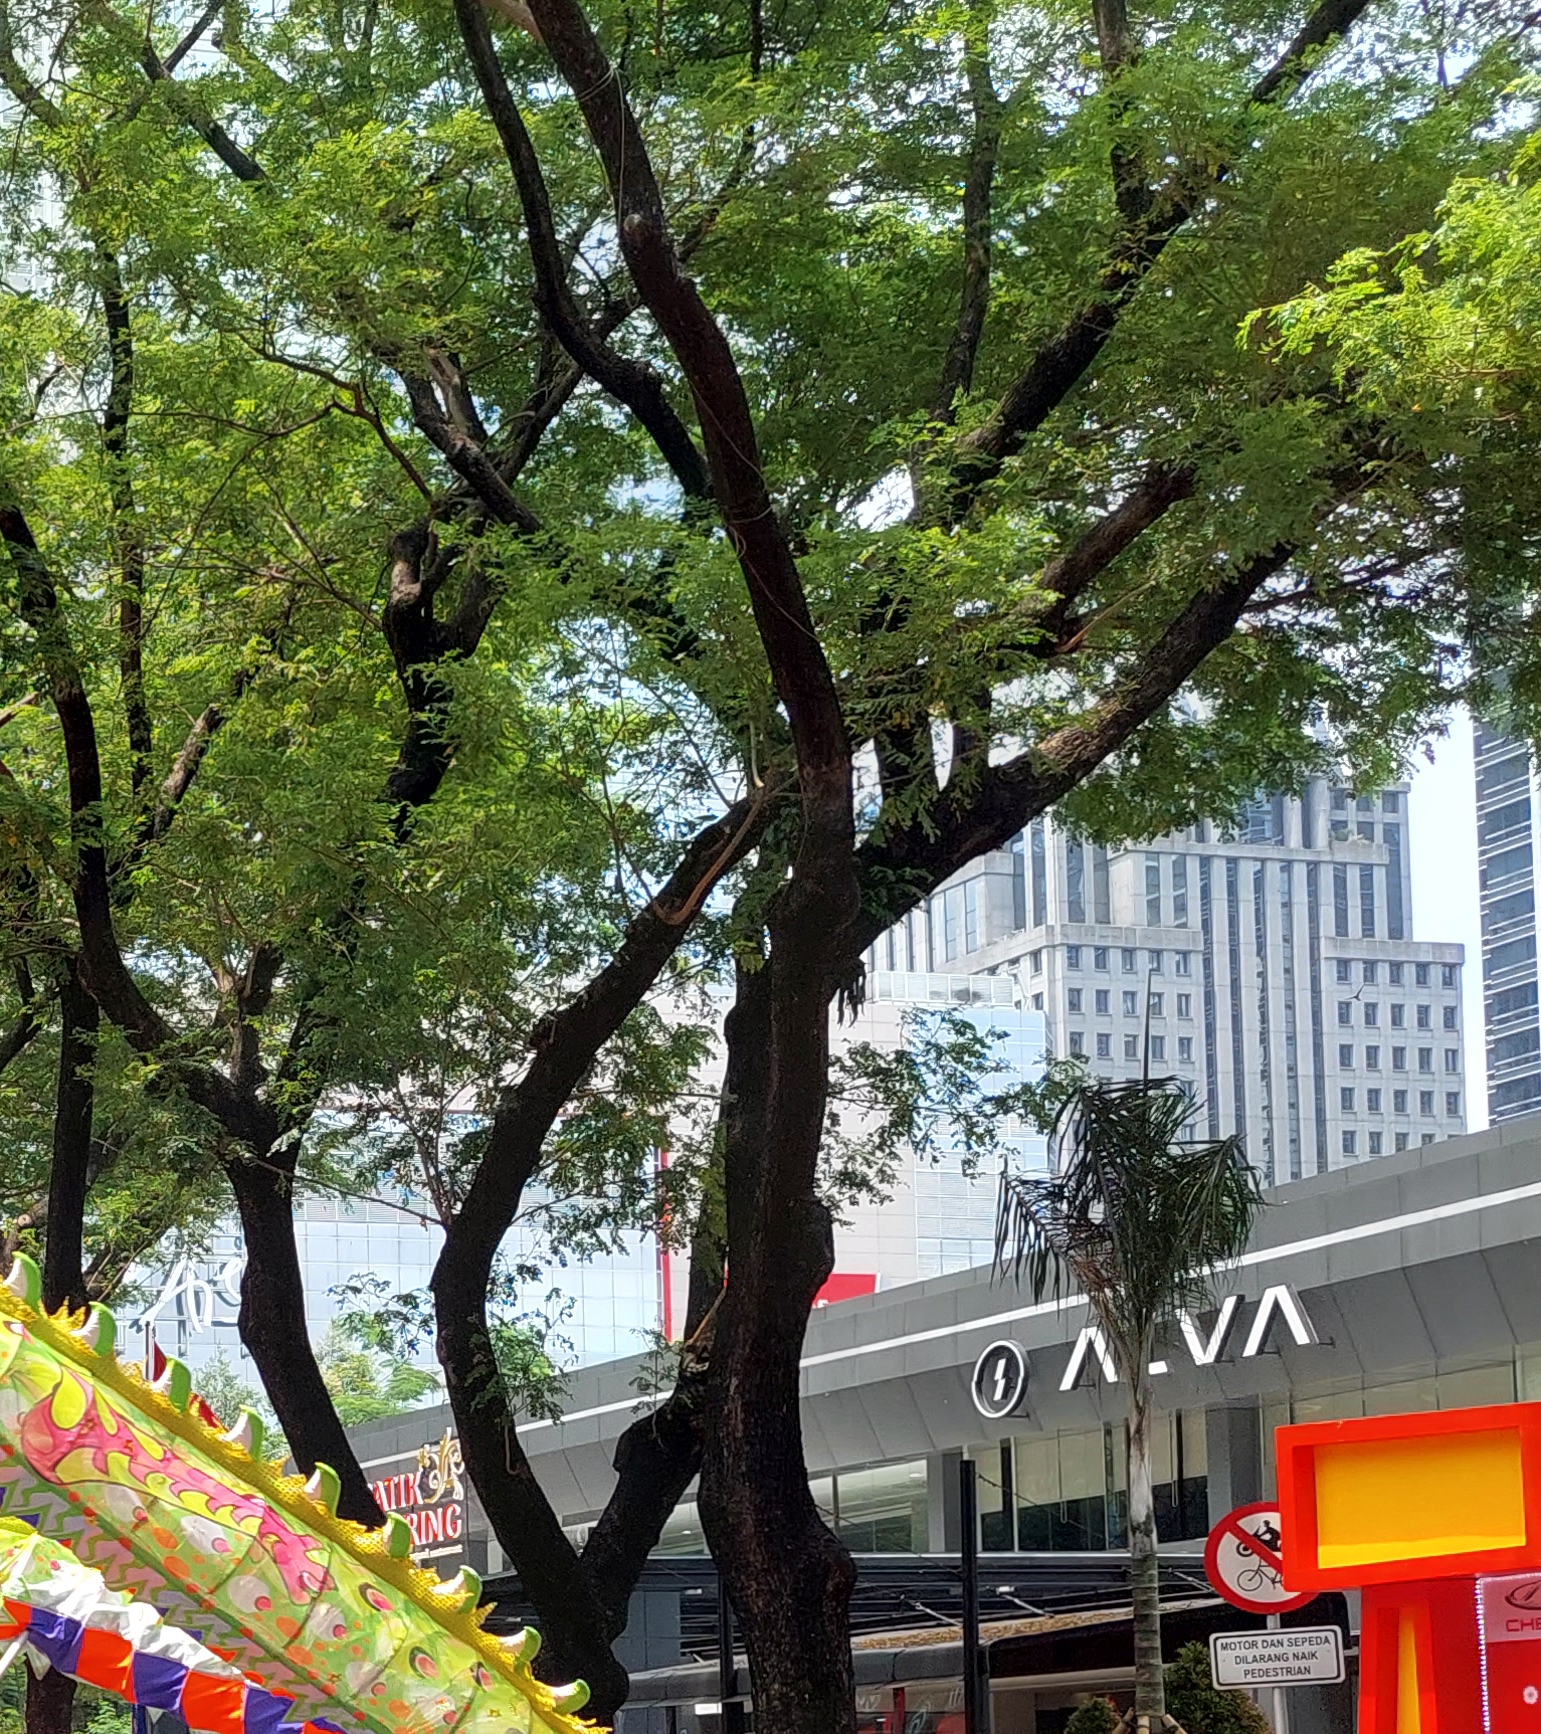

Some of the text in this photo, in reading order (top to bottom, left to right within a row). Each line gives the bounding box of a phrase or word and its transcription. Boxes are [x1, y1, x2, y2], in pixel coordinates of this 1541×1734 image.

[370, 1472, 424, 1511] ATIK
[408, 1504, 462, 1546] RING
[1220, 1636, 1331, 1652] MOTOR DAN SEPEDA
[1234, 1651, 1319, 1665] DILARANG NAIK
[1243, 1666, 1311, 1679] PEDESTRIAN
